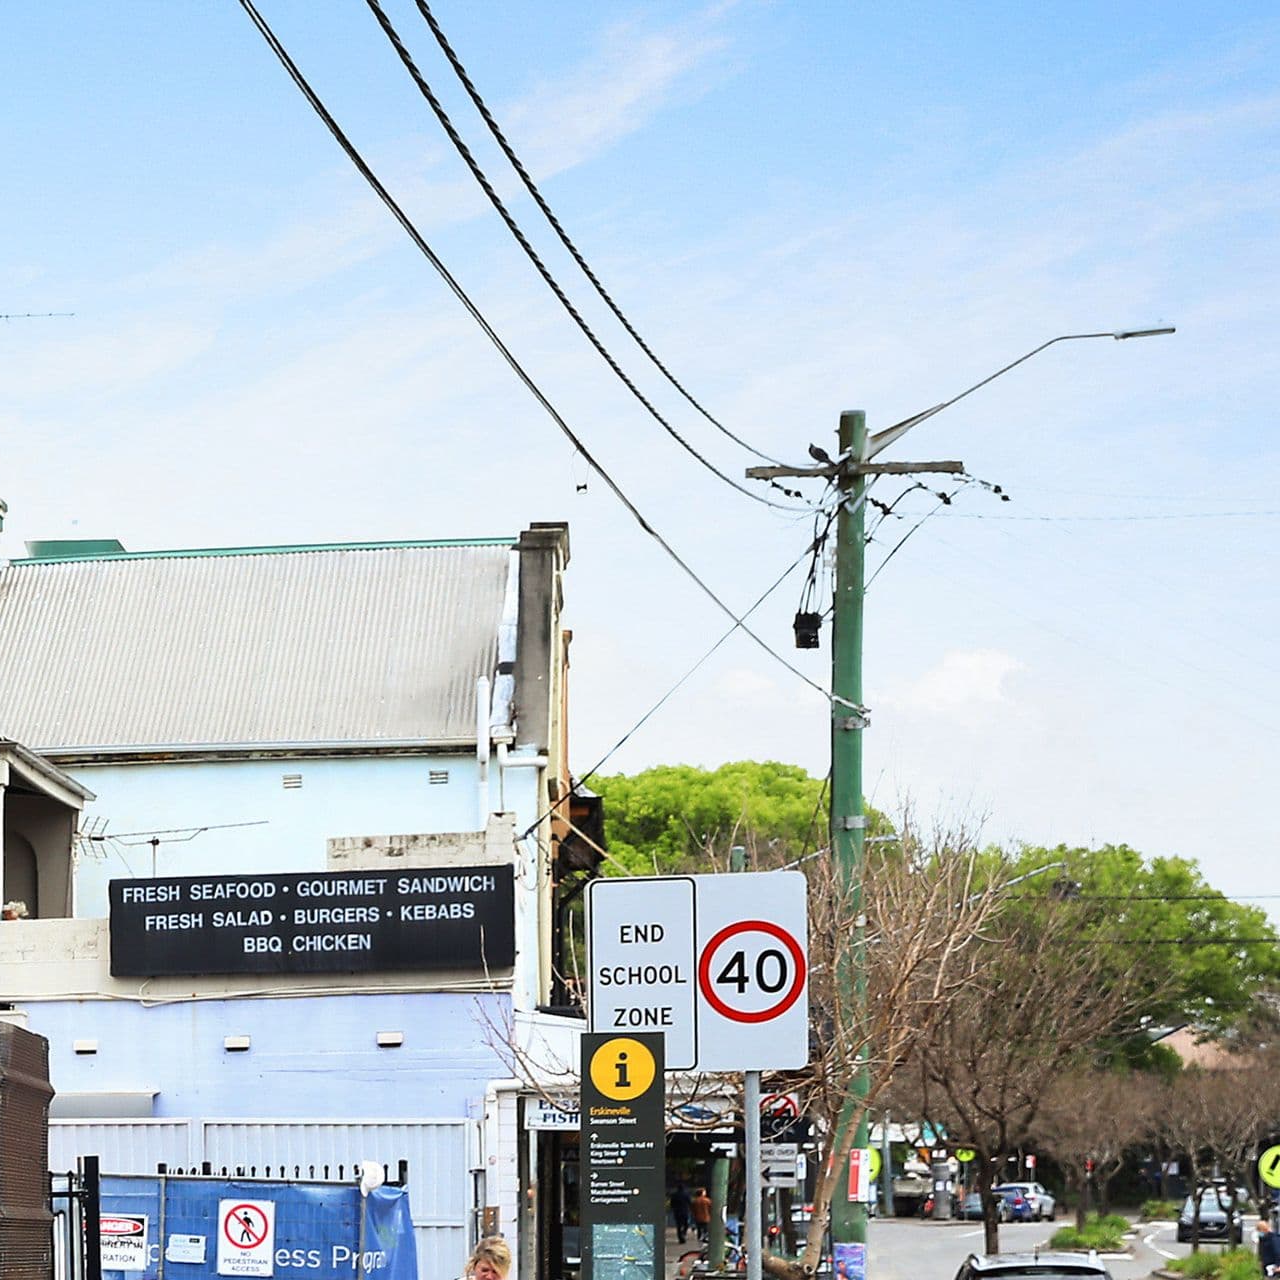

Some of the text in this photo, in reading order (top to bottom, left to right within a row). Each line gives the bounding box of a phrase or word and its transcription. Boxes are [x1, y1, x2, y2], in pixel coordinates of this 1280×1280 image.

[123, 875, 496, 903] FRESH SEAFOOD GOURMET SANDWICH
[145, 902, 475, 931] FRESH SALAD BURGERS KEBABS
[243, 933, 372, 954] BBQ CHICKEN
[620, 924, 664, 944] END
[599, 965, 687, 986] SCHOOL
[716, 949, 788, 994] 40
[613, 1007, 674, 1027] ZONE
[103, 1254, 136, 1262] RATION
[275, 1247, 321, 1268] ess
